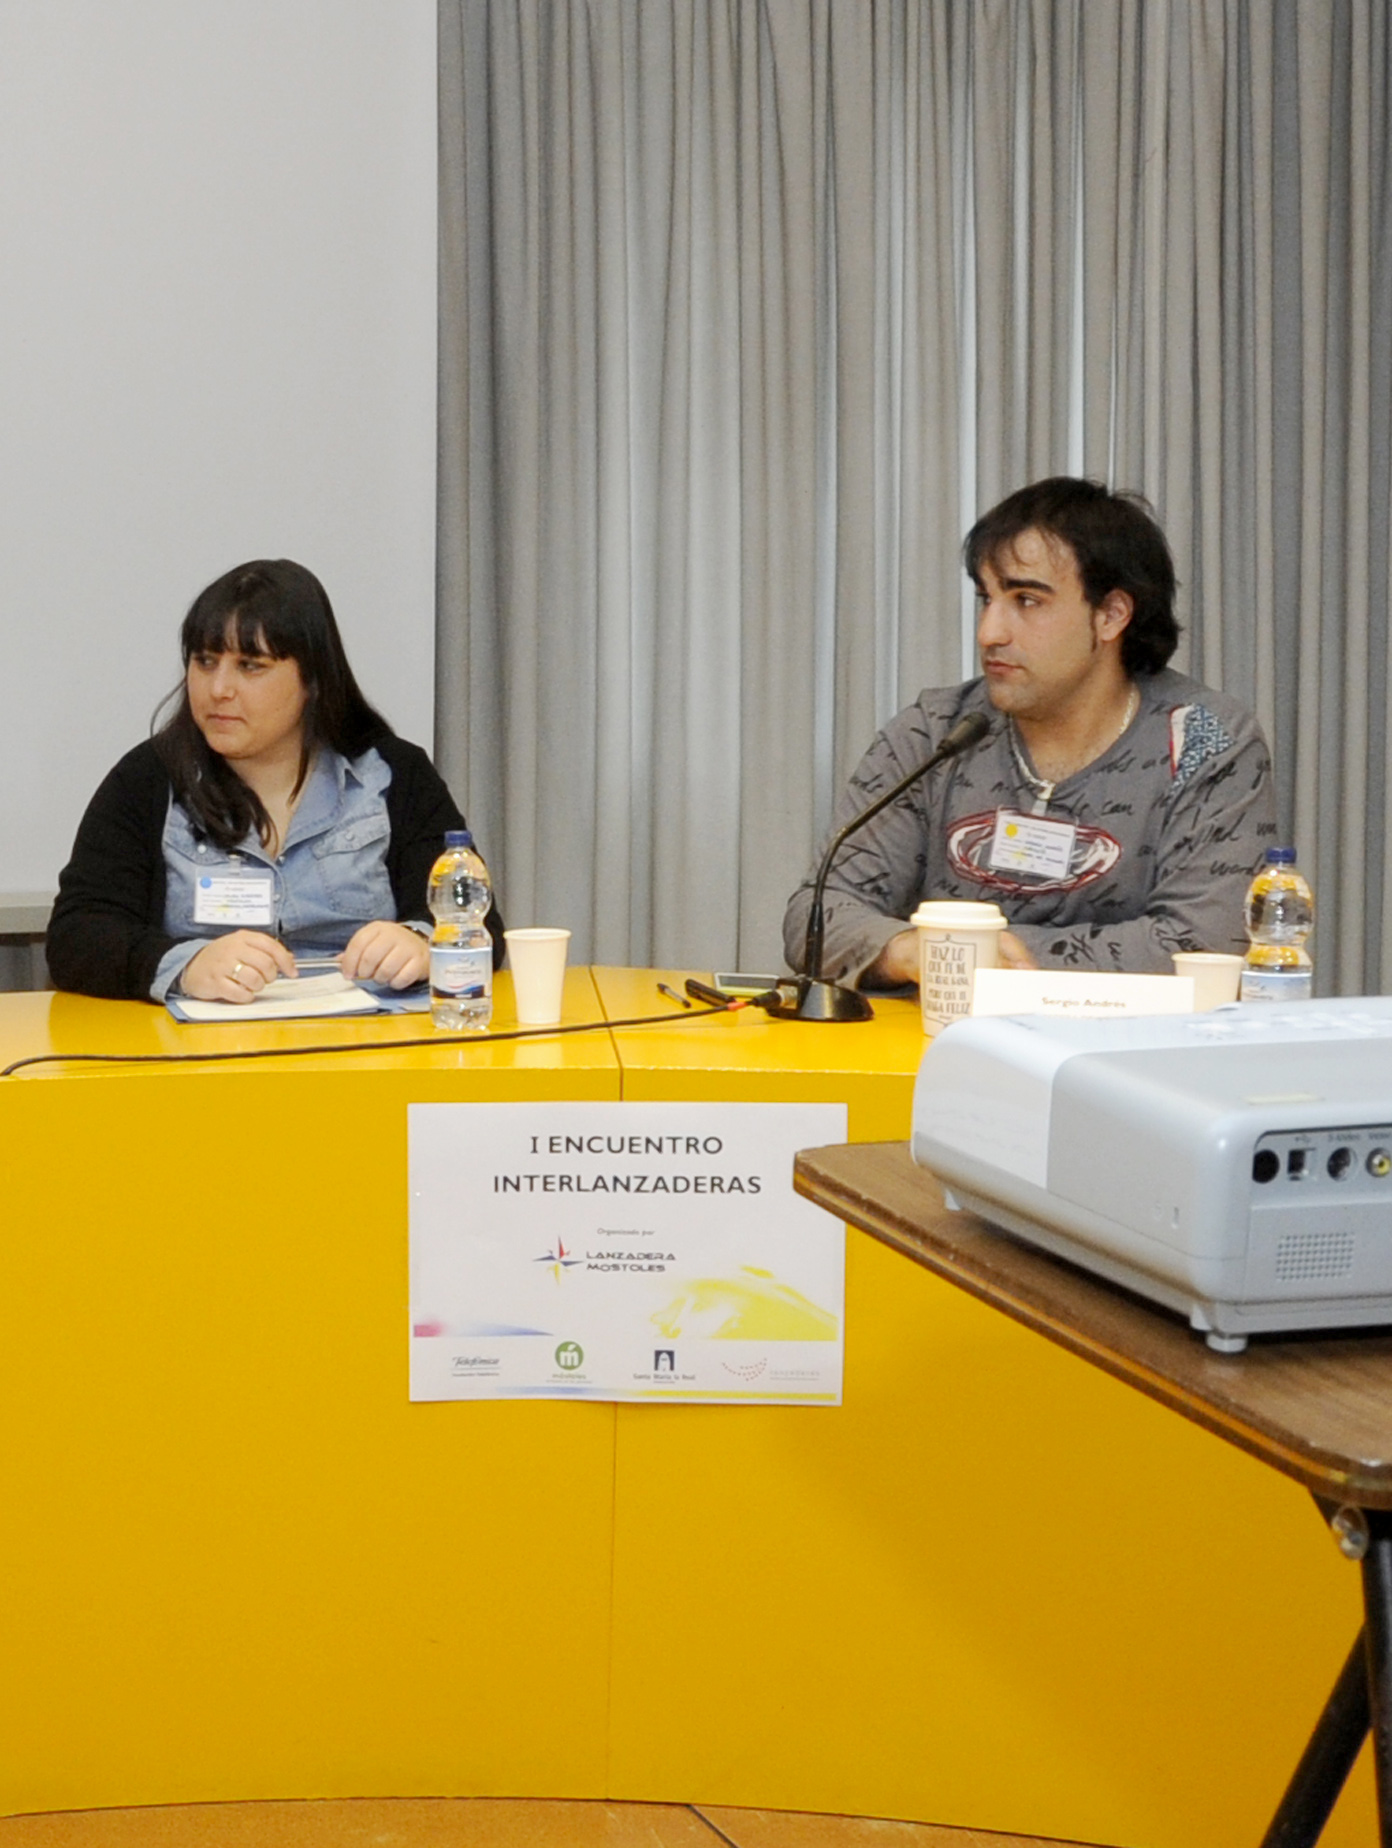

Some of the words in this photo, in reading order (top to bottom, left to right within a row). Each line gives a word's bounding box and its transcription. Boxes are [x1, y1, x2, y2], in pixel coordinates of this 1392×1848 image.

[530, 1136, 539, 1154] I
[548, 1135, 723, 1155] ENCUENTRO
[493, 1174, 762, 1194] INTERLANZADERAS
[585, 1250, 676, 1261] LANZADERA
[586, 1262, 666, 1273] MOSTOLES
